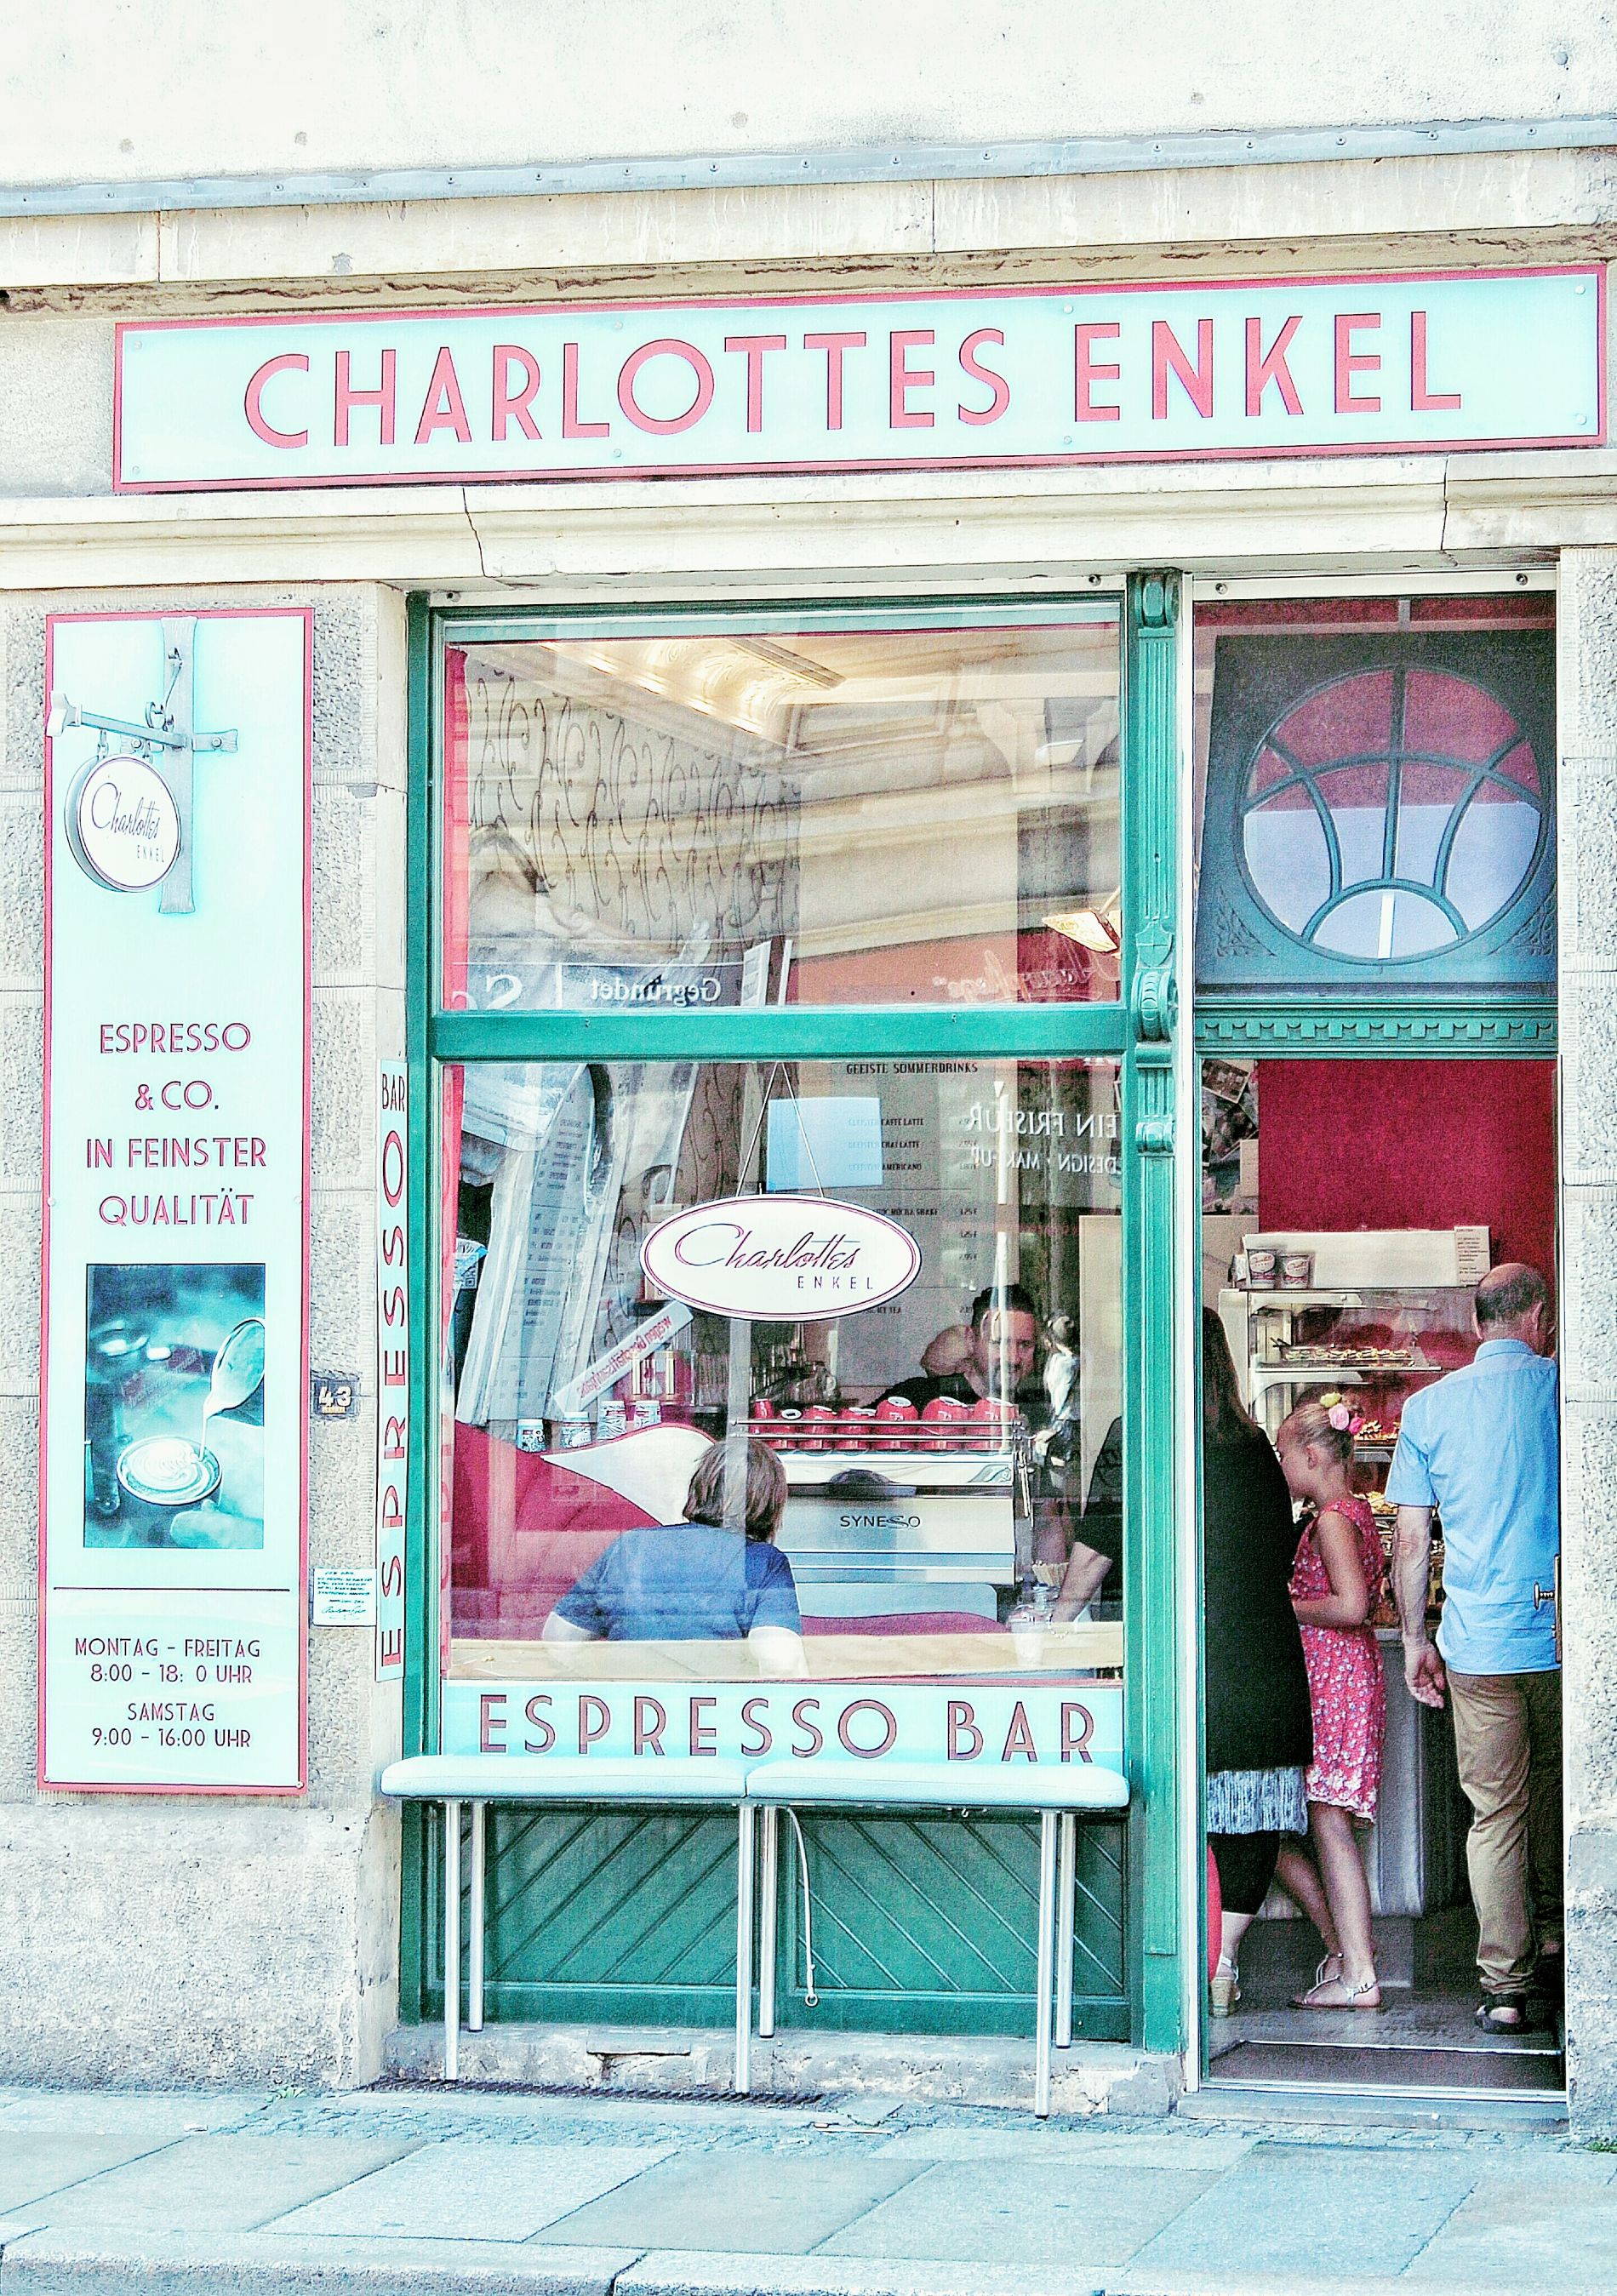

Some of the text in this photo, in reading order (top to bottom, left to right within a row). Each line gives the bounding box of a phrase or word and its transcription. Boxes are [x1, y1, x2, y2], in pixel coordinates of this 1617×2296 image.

[244, 311, 1461, 448] CHARLOTTES ENKEL
[91, 782, 160, 840] Charlottes
[137, 844, 164, 863] ENKEL
[100, 1023, 251, 1054] ESPRESSO
[893, 1063, 979, 1075] SOMMERDRINKS
[135, 1081, 220, 1111] & CO.
[382, 1073, 405, 1112] BAR
[87, 1137, 266, 1168] IN FEINSTER
[100, 1188, 254, 1226] QUALITÄT
[674, 1223, 861, 1270] Charlottes
[797, 1276, 873, 1289] ENKEL
[318, 1385, 352, 1408] 43
[380, 1130, 407, 1666] ESPRESSO
[840, 1515, 921, 1529] SYNESSO
[75, 1637, 158, 1656] MONTAG
[185, 1639, 260, 1658] FREITAG
[90, 1664, 132, 1682] 8:00
[216, 1665, 252, 1683] UHR
[128, 1703, 214, 1722] SAMSTAG
[92, 1728, 132, 1746] 9:00
[158, 1728, 205, 1746] 16:00
[214, 1729, 251, 1747] UHR
[479, 1693, 1094, 1763] ESPRESSO BAR
